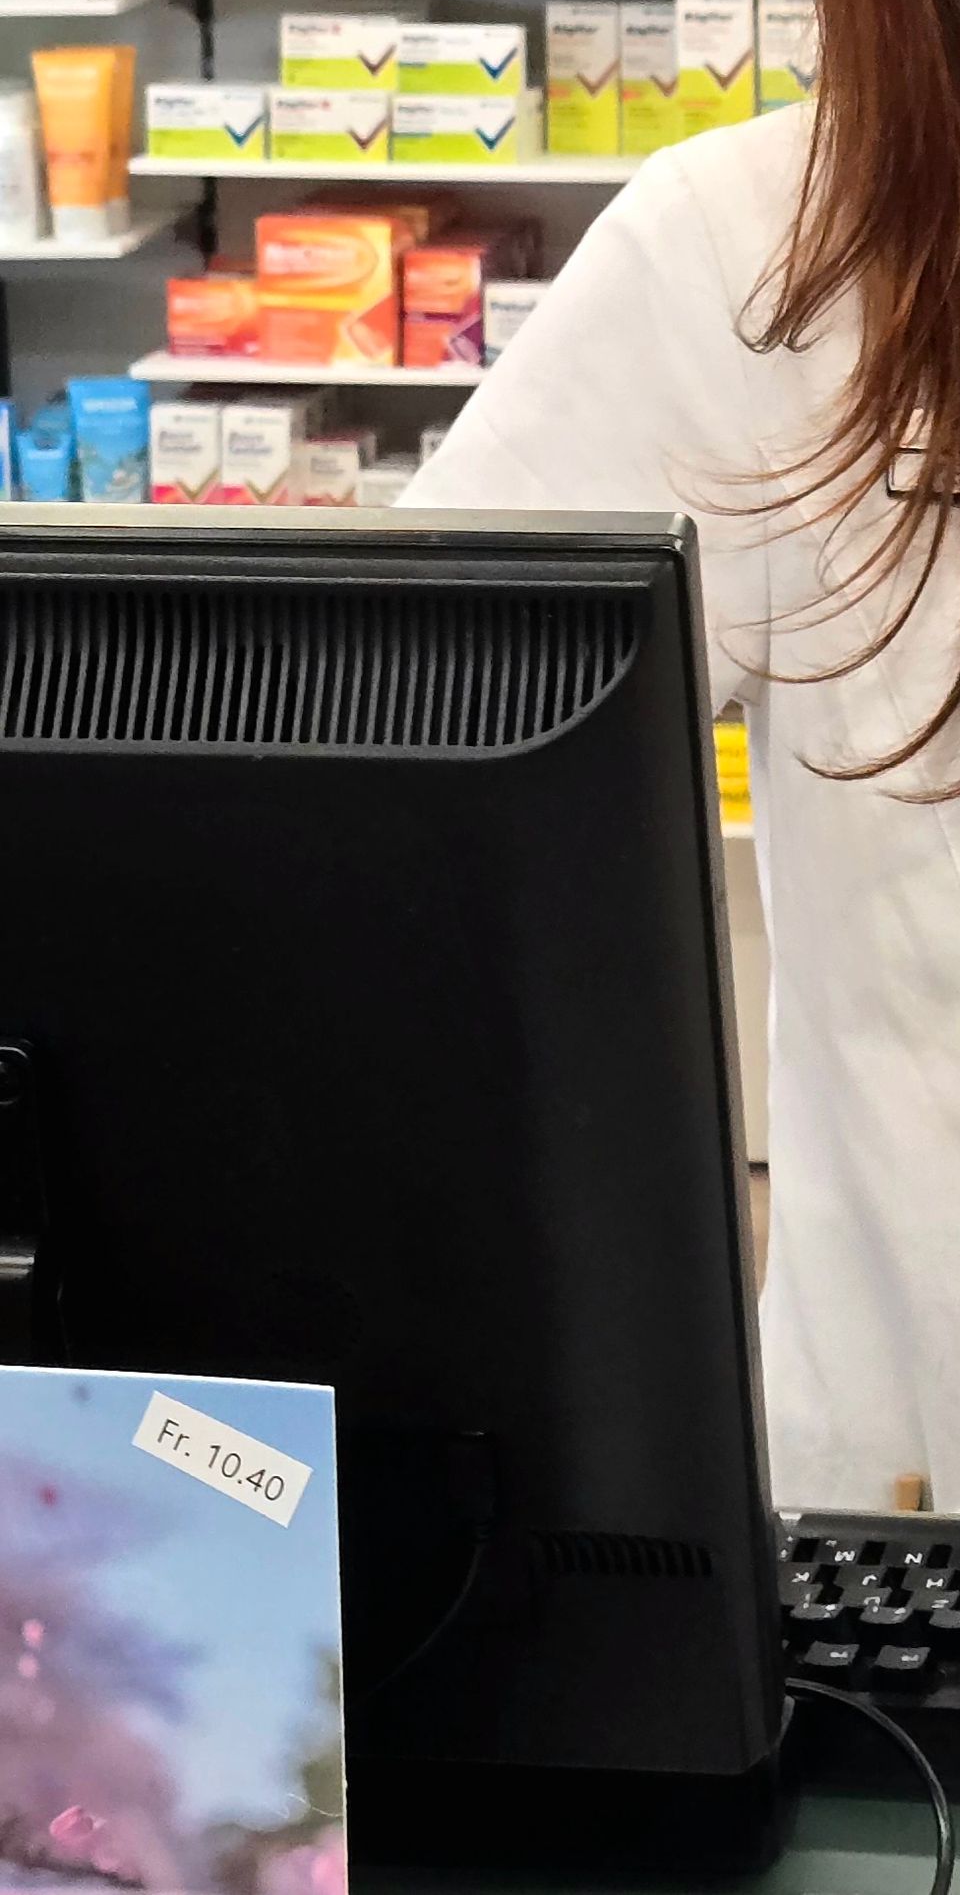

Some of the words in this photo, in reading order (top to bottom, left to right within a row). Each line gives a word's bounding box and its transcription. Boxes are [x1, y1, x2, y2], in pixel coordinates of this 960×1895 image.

[157, 1418, 191, 1457] Fr.
[208, 1444, 285, 1501] 10.40
[834, 1550, 855, 1562] M
[904, 1552, 923, 1564] N
[792, 1571, 810, 1583] K
[925, 1578, 944, 1589] H
[863, 1596, 881, 1608] U
